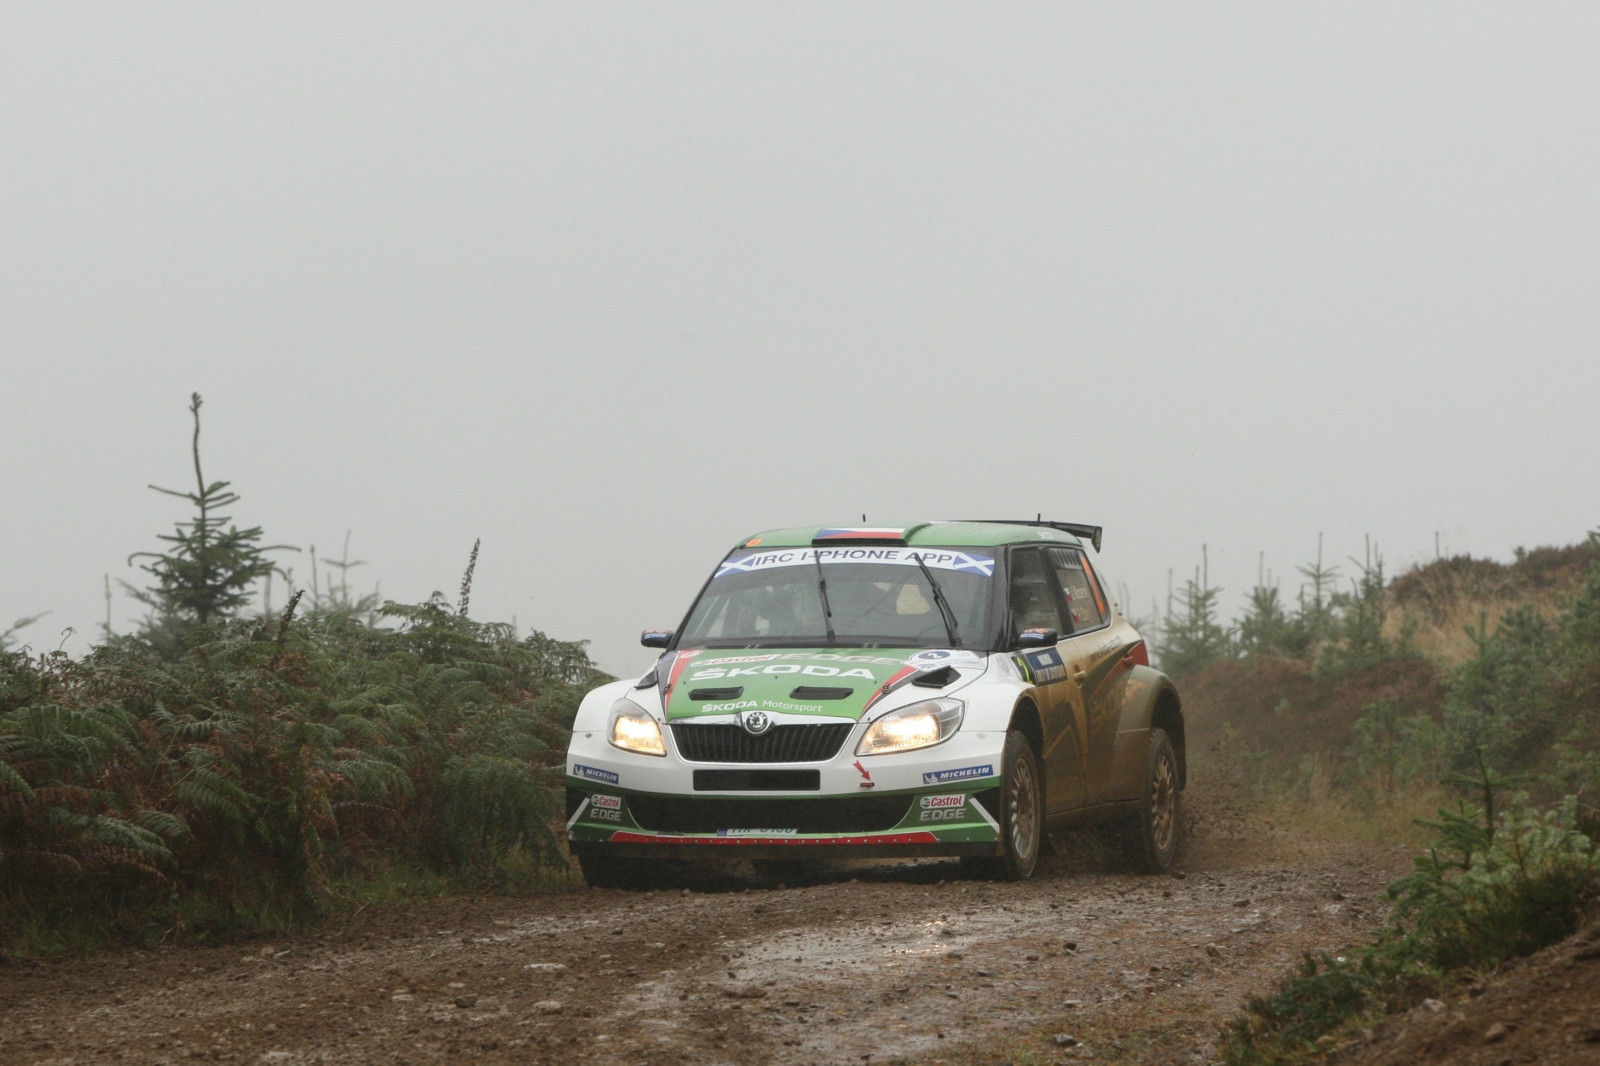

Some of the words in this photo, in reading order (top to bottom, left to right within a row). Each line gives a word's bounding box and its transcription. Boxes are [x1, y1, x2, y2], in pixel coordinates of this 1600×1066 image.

[754, 553, 794, 566] IRC
[801, 550, 900, 561] I-PHONE
[904, 552, 953, 563] APP
[778, 653, 901, 665] EDGE
[689, 664, 875, 681] ŠKODA
[701, 700, 758, 713] ŠKODA
[763, 700, 822, 712] Motorsport
[586, 769, 618, 781] MICHELIN
[940, 767, 990, 779] MICHELIN
[599, 796, 620, 808] Castrol
[930, 796, 963, 807] Castrol
[590, 808, 622, 821] EDGE
[919, 808, 967, 821] EDGE
